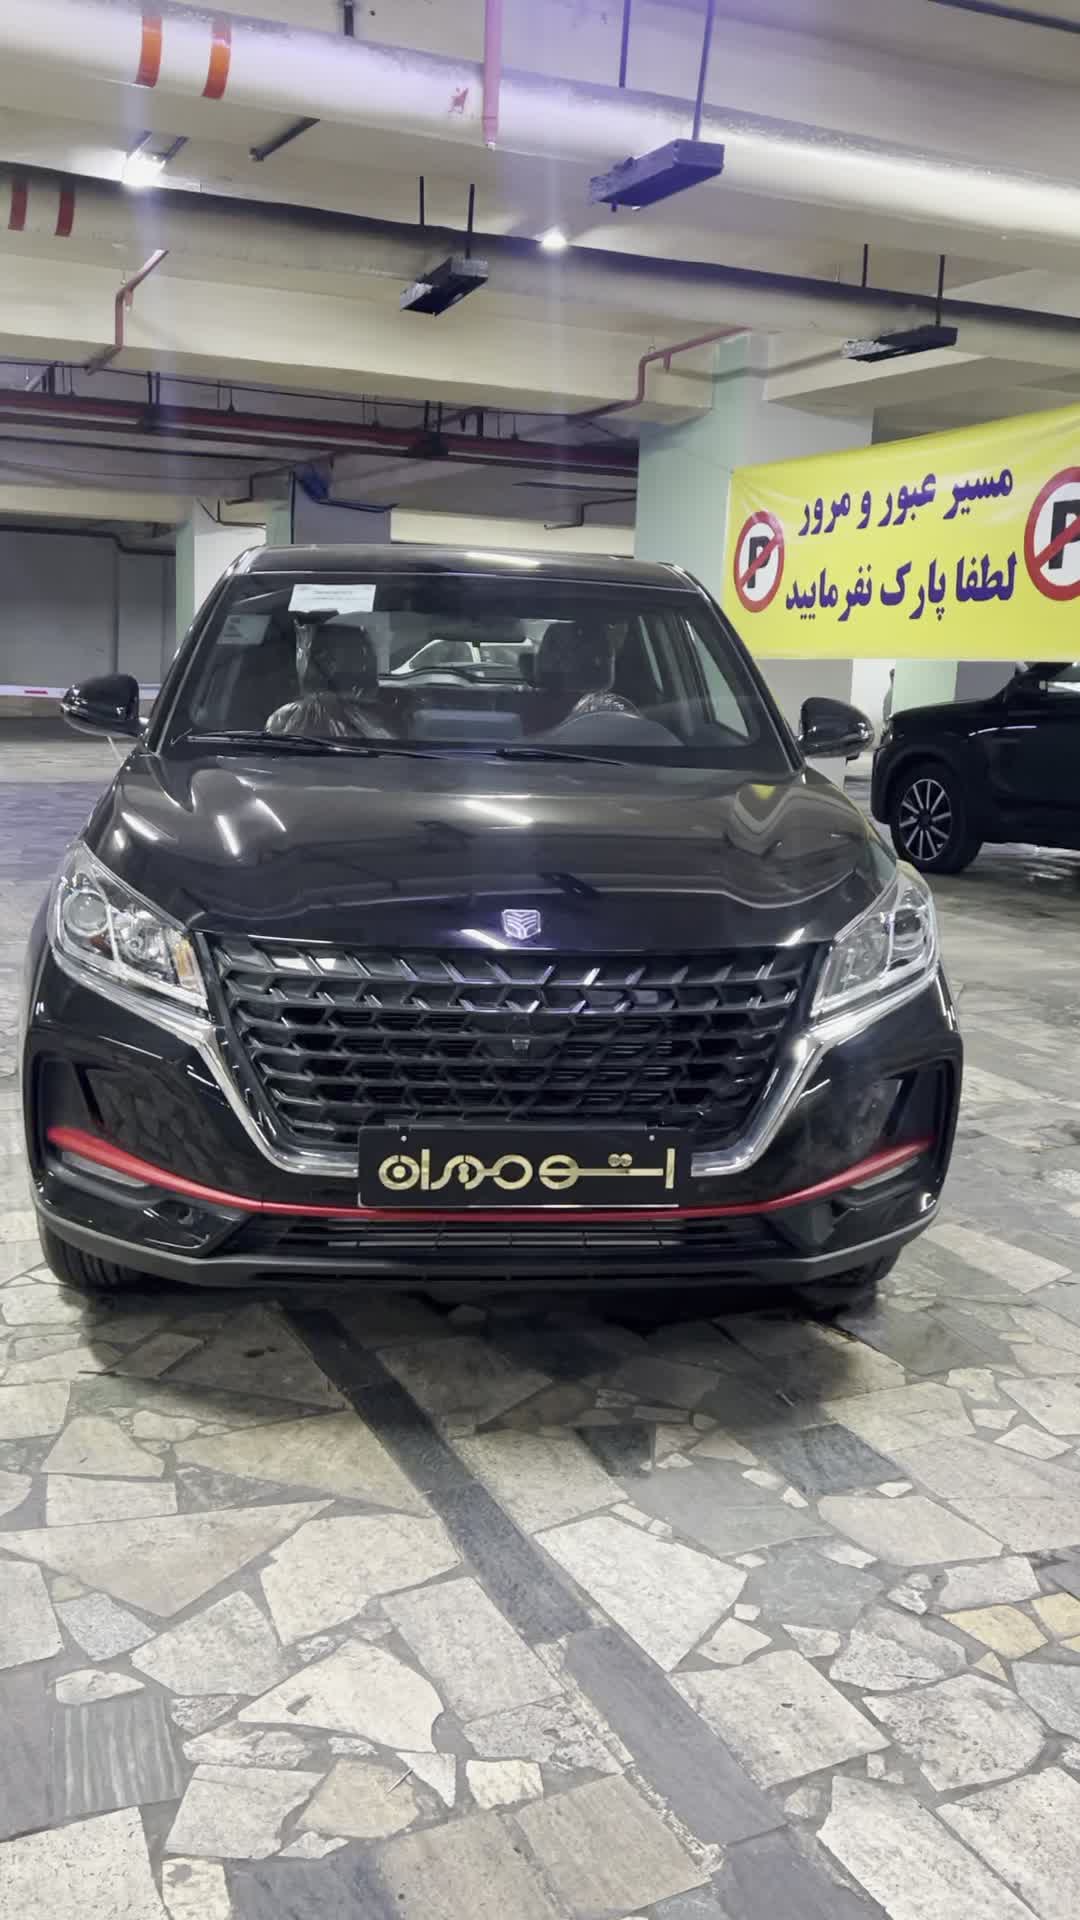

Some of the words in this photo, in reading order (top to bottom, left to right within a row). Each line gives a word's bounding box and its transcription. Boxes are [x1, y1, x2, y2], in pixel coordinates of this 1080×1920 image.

[798, 492, 851, 536] مرور
[856, 490, 872, 529] و
[877, 473, 937, 527] عبور
[943, 469, 1013, 520] مسیر
[785, 564, 873, 621] نفرمایید
[879, 559, 946, 620] پارک
[955, 552, 1017, 602] لطفا
